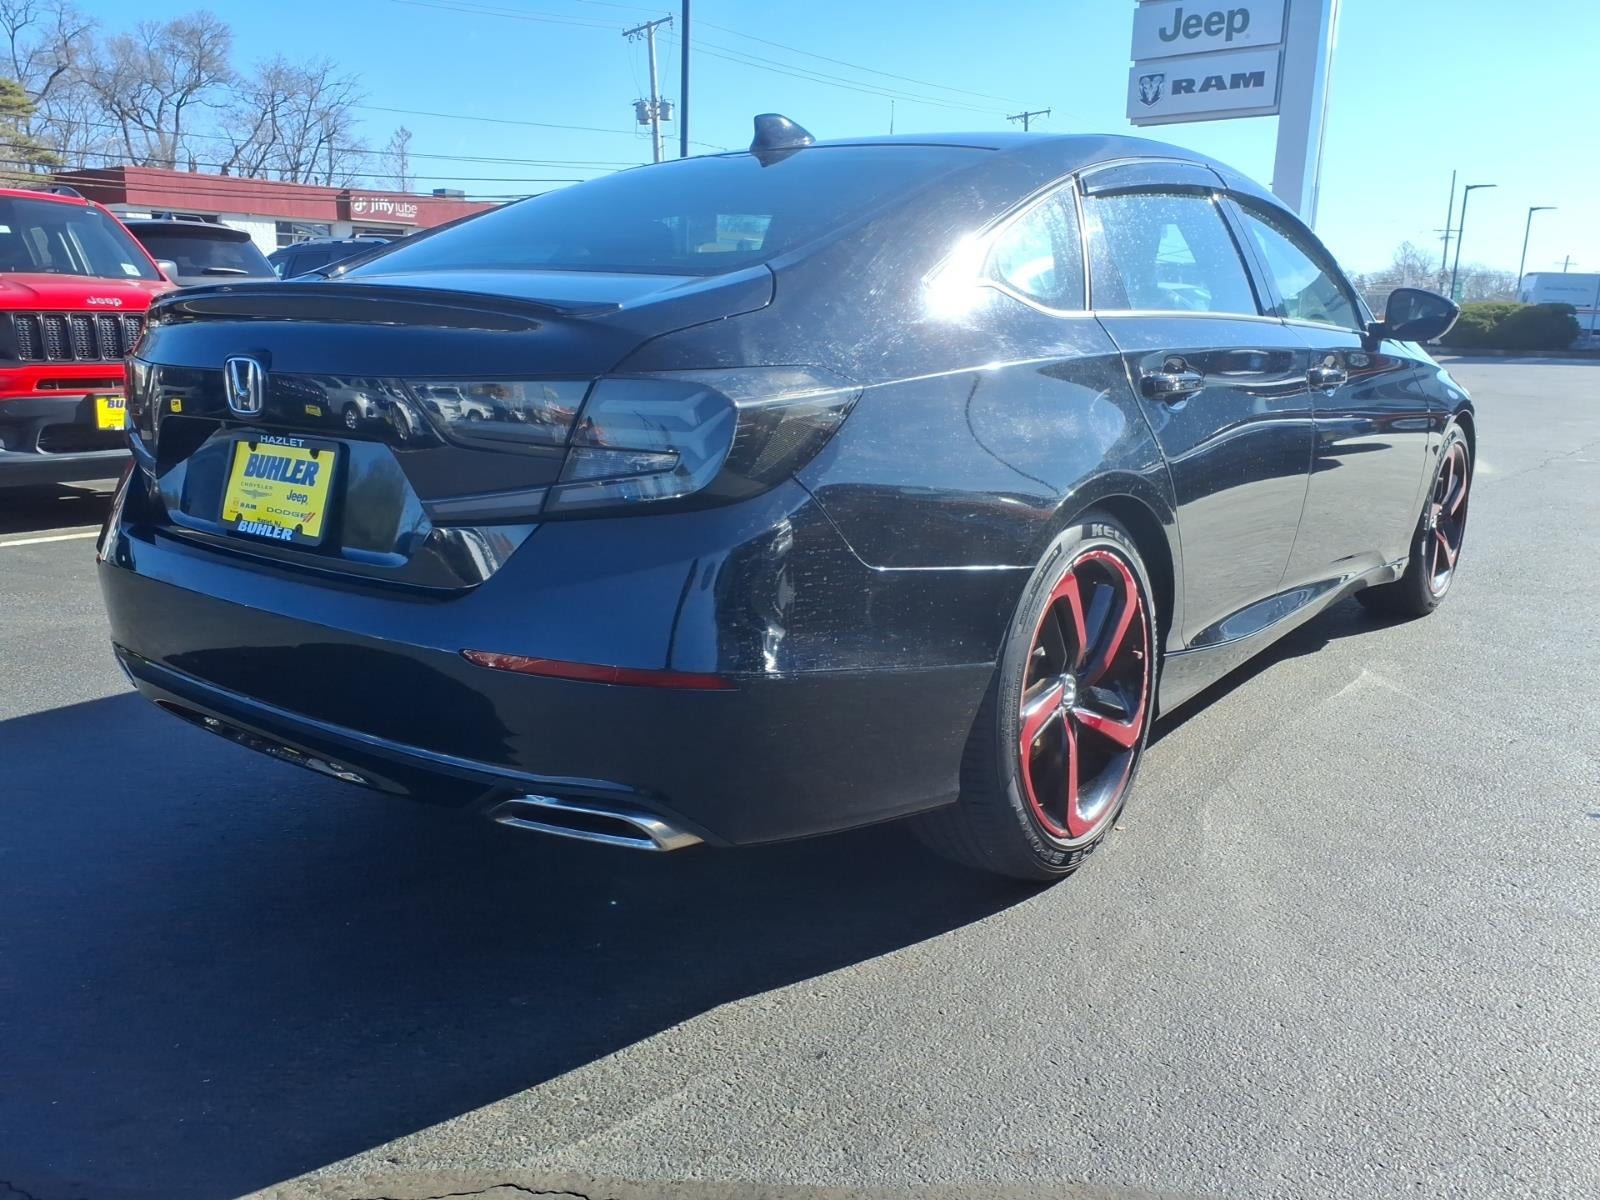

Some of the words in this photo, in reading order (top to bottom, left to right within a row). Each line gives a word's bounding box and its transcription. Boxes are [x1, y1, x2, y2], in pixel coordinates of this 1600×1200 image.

[1158, 7, 1250, 42] Jeep
[1171, 70, 1266, 96] RAM
[86, 295, 123, 307] Jeep
[260, 434, 305, 448] HAZLET
[243, 452, 320, 487] BUHLER
[286, 489, 308, 505] Jeep
[266, 506, 307, 519] DODGE
[237, 520, 293, 541] BUHLER
